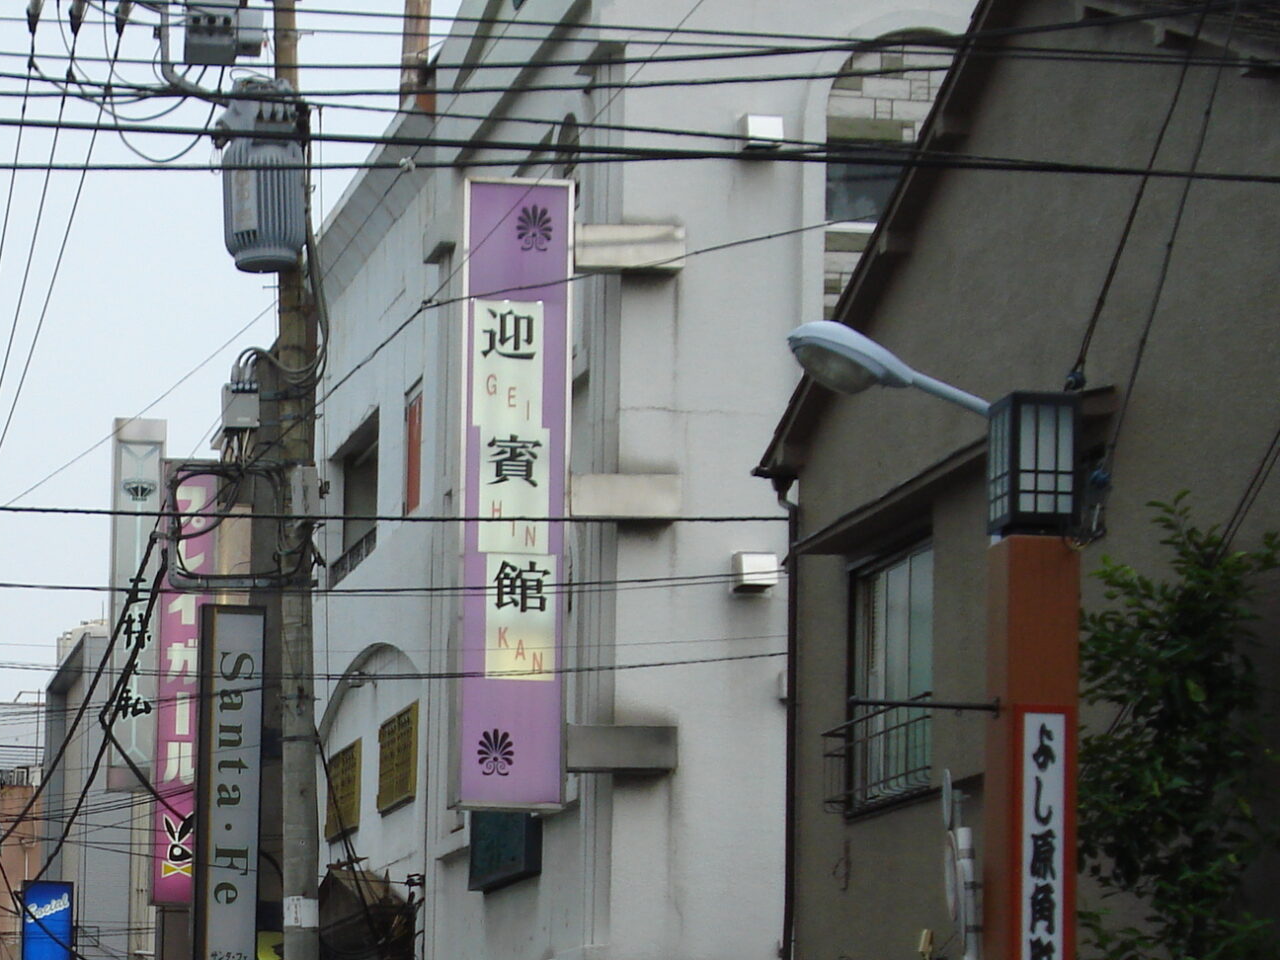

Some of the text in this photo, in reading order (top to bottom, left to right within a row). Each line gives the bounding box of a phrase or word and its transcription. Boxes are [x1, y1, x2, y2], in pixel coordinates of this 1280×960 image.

[481, 308, 536, 360] 迎
[486, 374, 531, 421] GEI
[487, 435, 542, 488] 賓
[491, 500, 536, 548] HIN
[493, 560, 551, 613] 館
[498, 626, 543, 675] KAN
